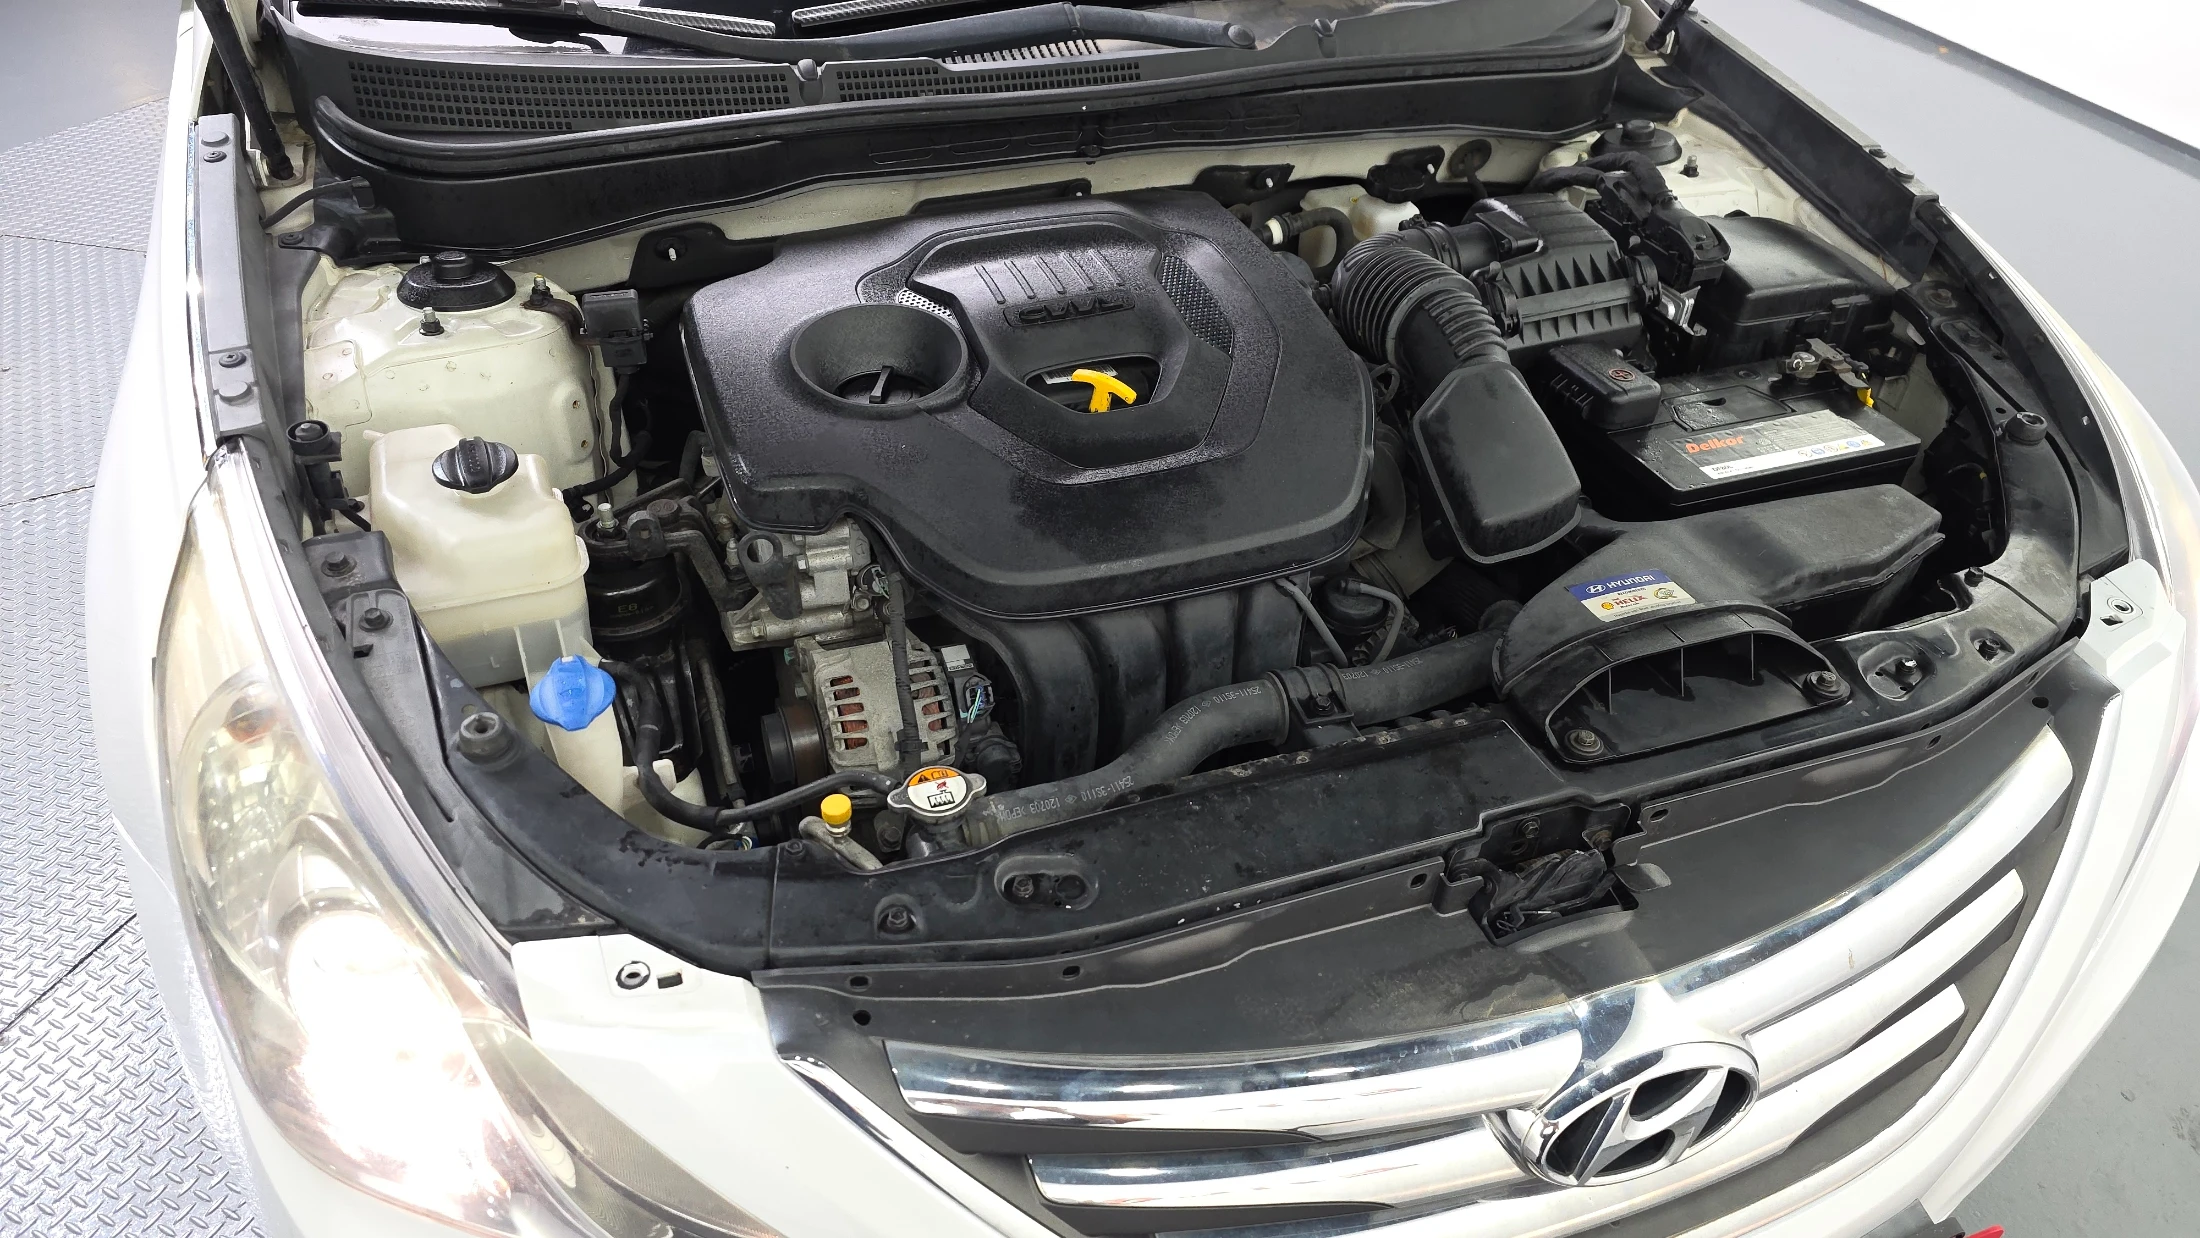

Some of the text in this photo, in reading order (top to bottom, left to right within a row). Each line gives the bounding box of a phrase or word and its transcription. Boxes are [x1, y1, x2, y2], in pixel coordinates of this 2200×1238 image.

[1685, 435, 1744, 454] Delkor
[1606, 575, 1655, 588] HYUNDAI
[1212, 685, 1262, 704] 25411-3S110
[1080, 775, 1135, 802] 25411-3S110
[1029, 797, 1062, 815] 120703
